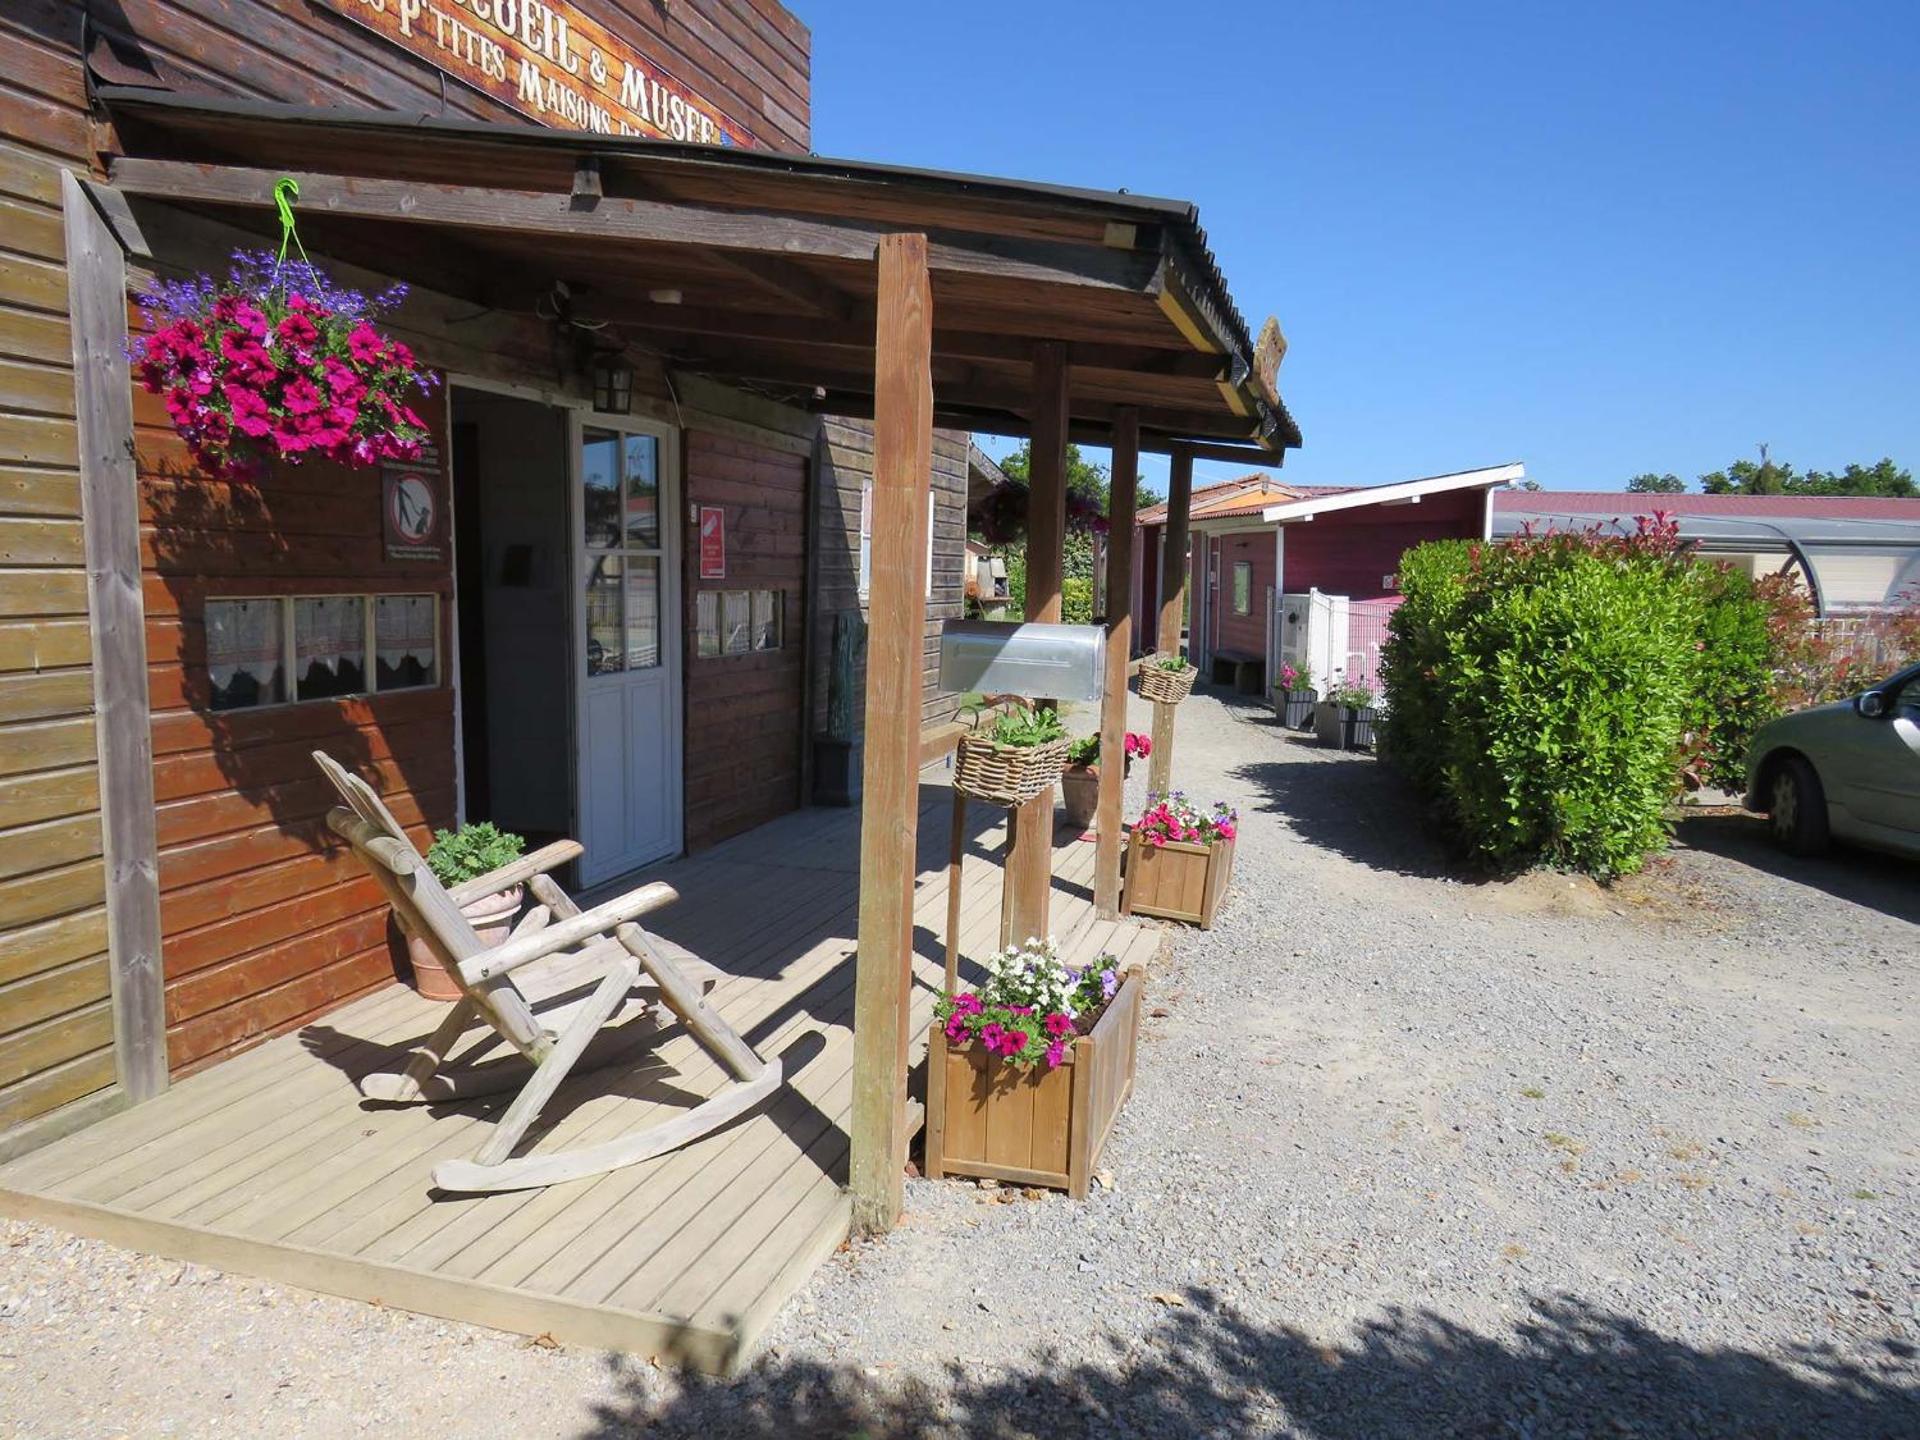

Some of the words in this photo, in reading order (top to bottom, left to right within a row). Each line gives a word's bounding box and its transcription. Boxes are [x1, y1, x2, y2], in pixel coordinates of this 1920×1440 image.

[399, 0, 506, 83] P'TITES
[517, 58, 612, 135] MAISONS
[589, 49, 608, 87] &
